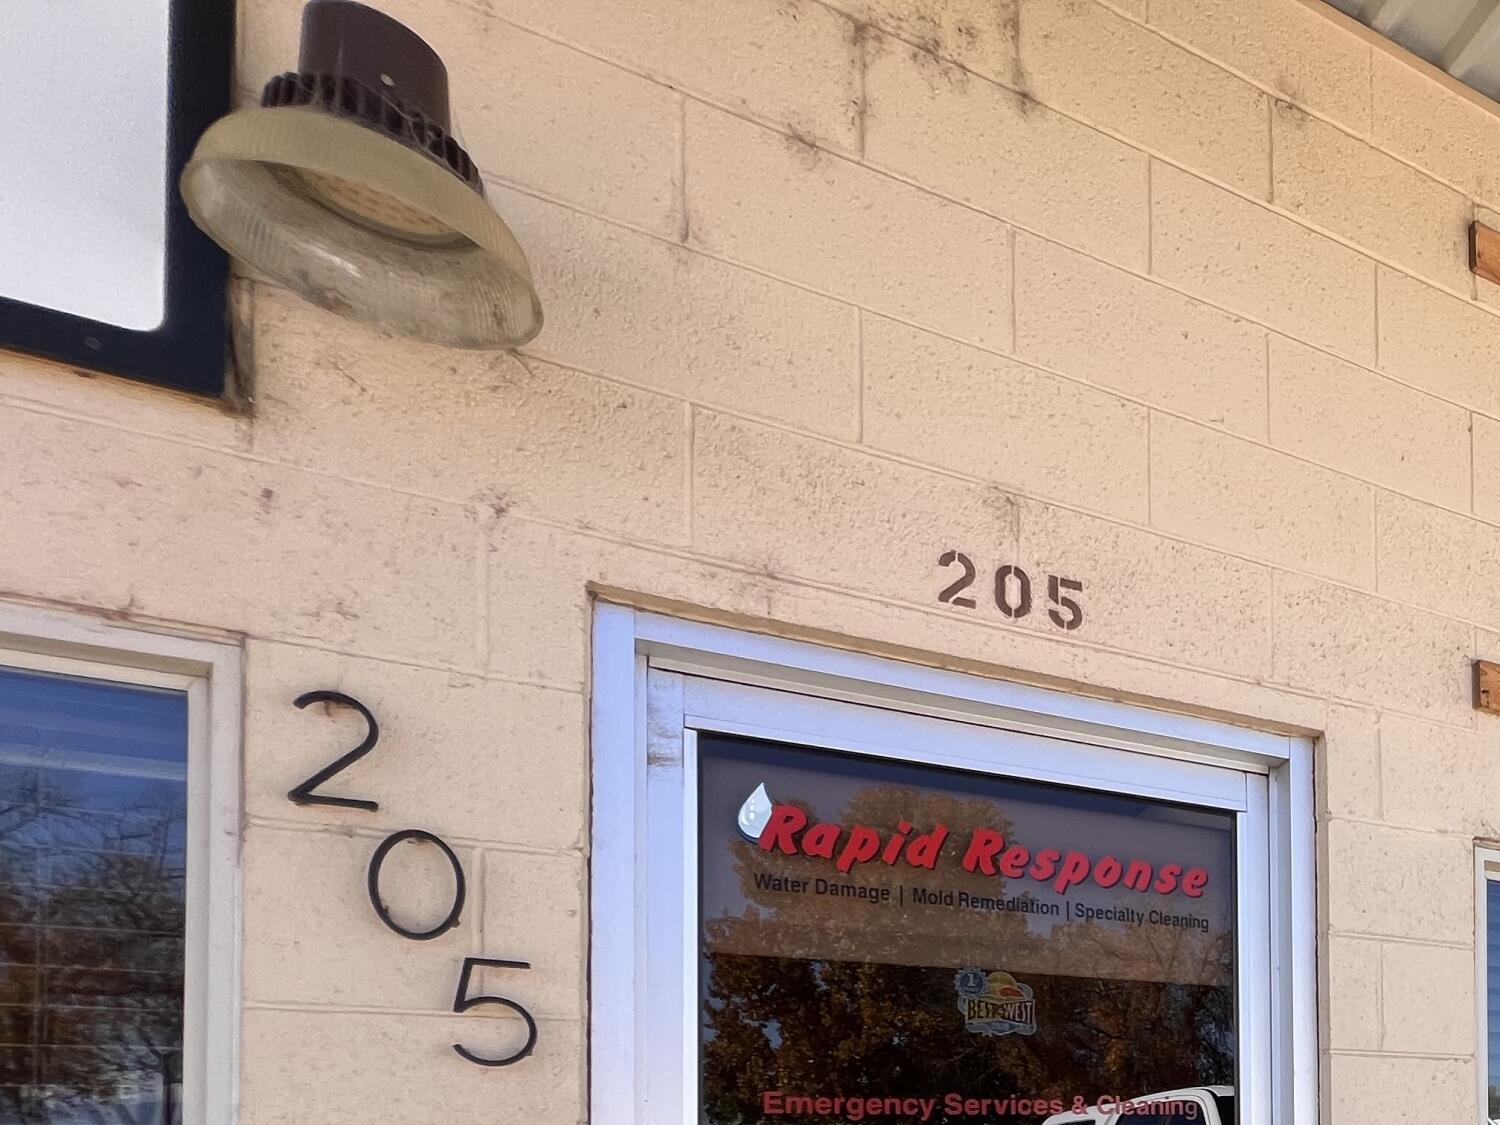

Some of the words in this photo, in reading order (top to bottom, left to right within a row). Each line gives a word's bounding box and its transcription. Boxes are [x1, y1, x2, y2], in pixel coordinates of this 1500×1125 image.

[938, 550, 1083, 630] 205
[287, 690, 537, 1067] 205
[758, 804, 950, 873] Rapid
[961, 827, 1208, 898] Response
[753, 872, 809, 894] Water
[815, 878, 890, 905] Damage
[912, 887, 953, 907] Mold
[958, 892, 1060, 916] Remediation
[1074, 902, 1144, 928] Specialty
[1149, 910, 1210, 933] Cleaning
[763, 1090, 941, 1121] Emergency
[944, 1093, 1063, 1116] Services
[1071, 1096, 1090, 1116] &
[1096, 1095, 1199, 1120] Cleaning
